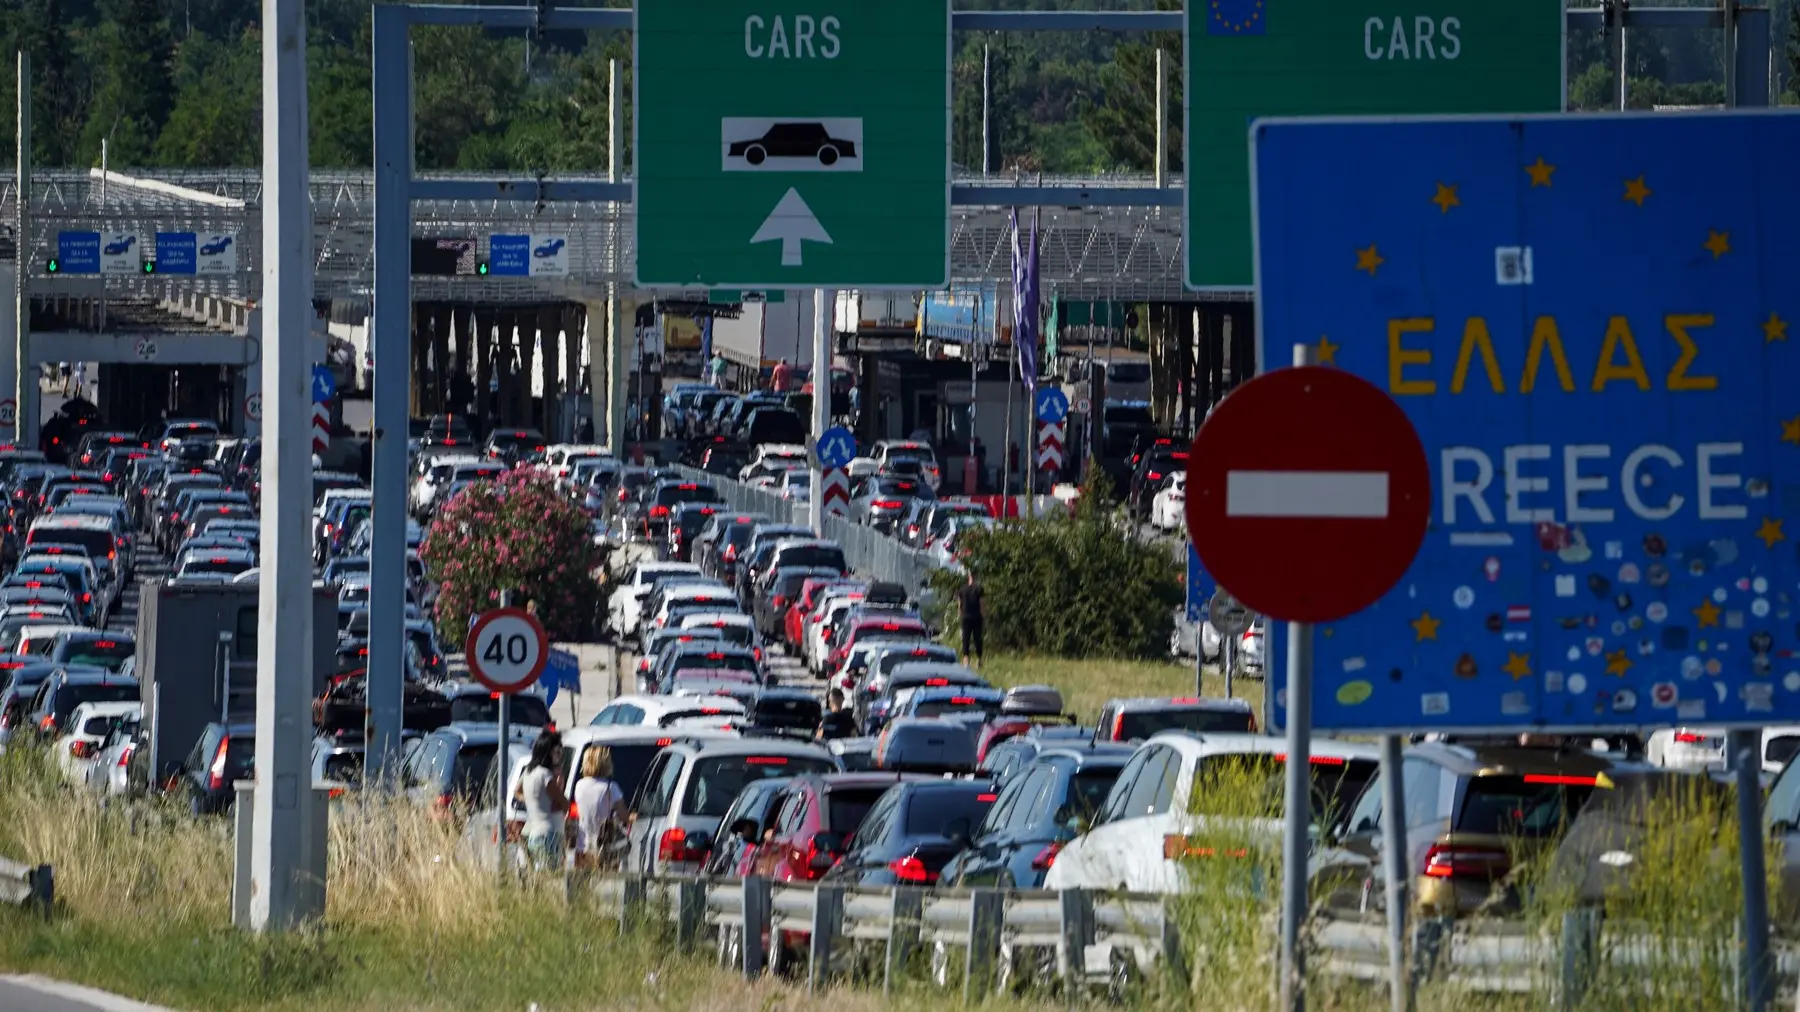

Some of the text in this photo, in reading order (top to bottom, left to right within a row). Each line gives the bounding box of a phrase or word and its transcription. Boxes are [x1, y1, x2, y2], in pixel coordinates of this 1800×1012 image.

[744, 15, 841, 59] CARS
[1364, 16, 1461, 60] CARS
[1387, 313, 1719, 396] ΕΛΛΑΣ
[1441, 441, 1748, 524] REECE
[483, 632, 528, 666] 40
